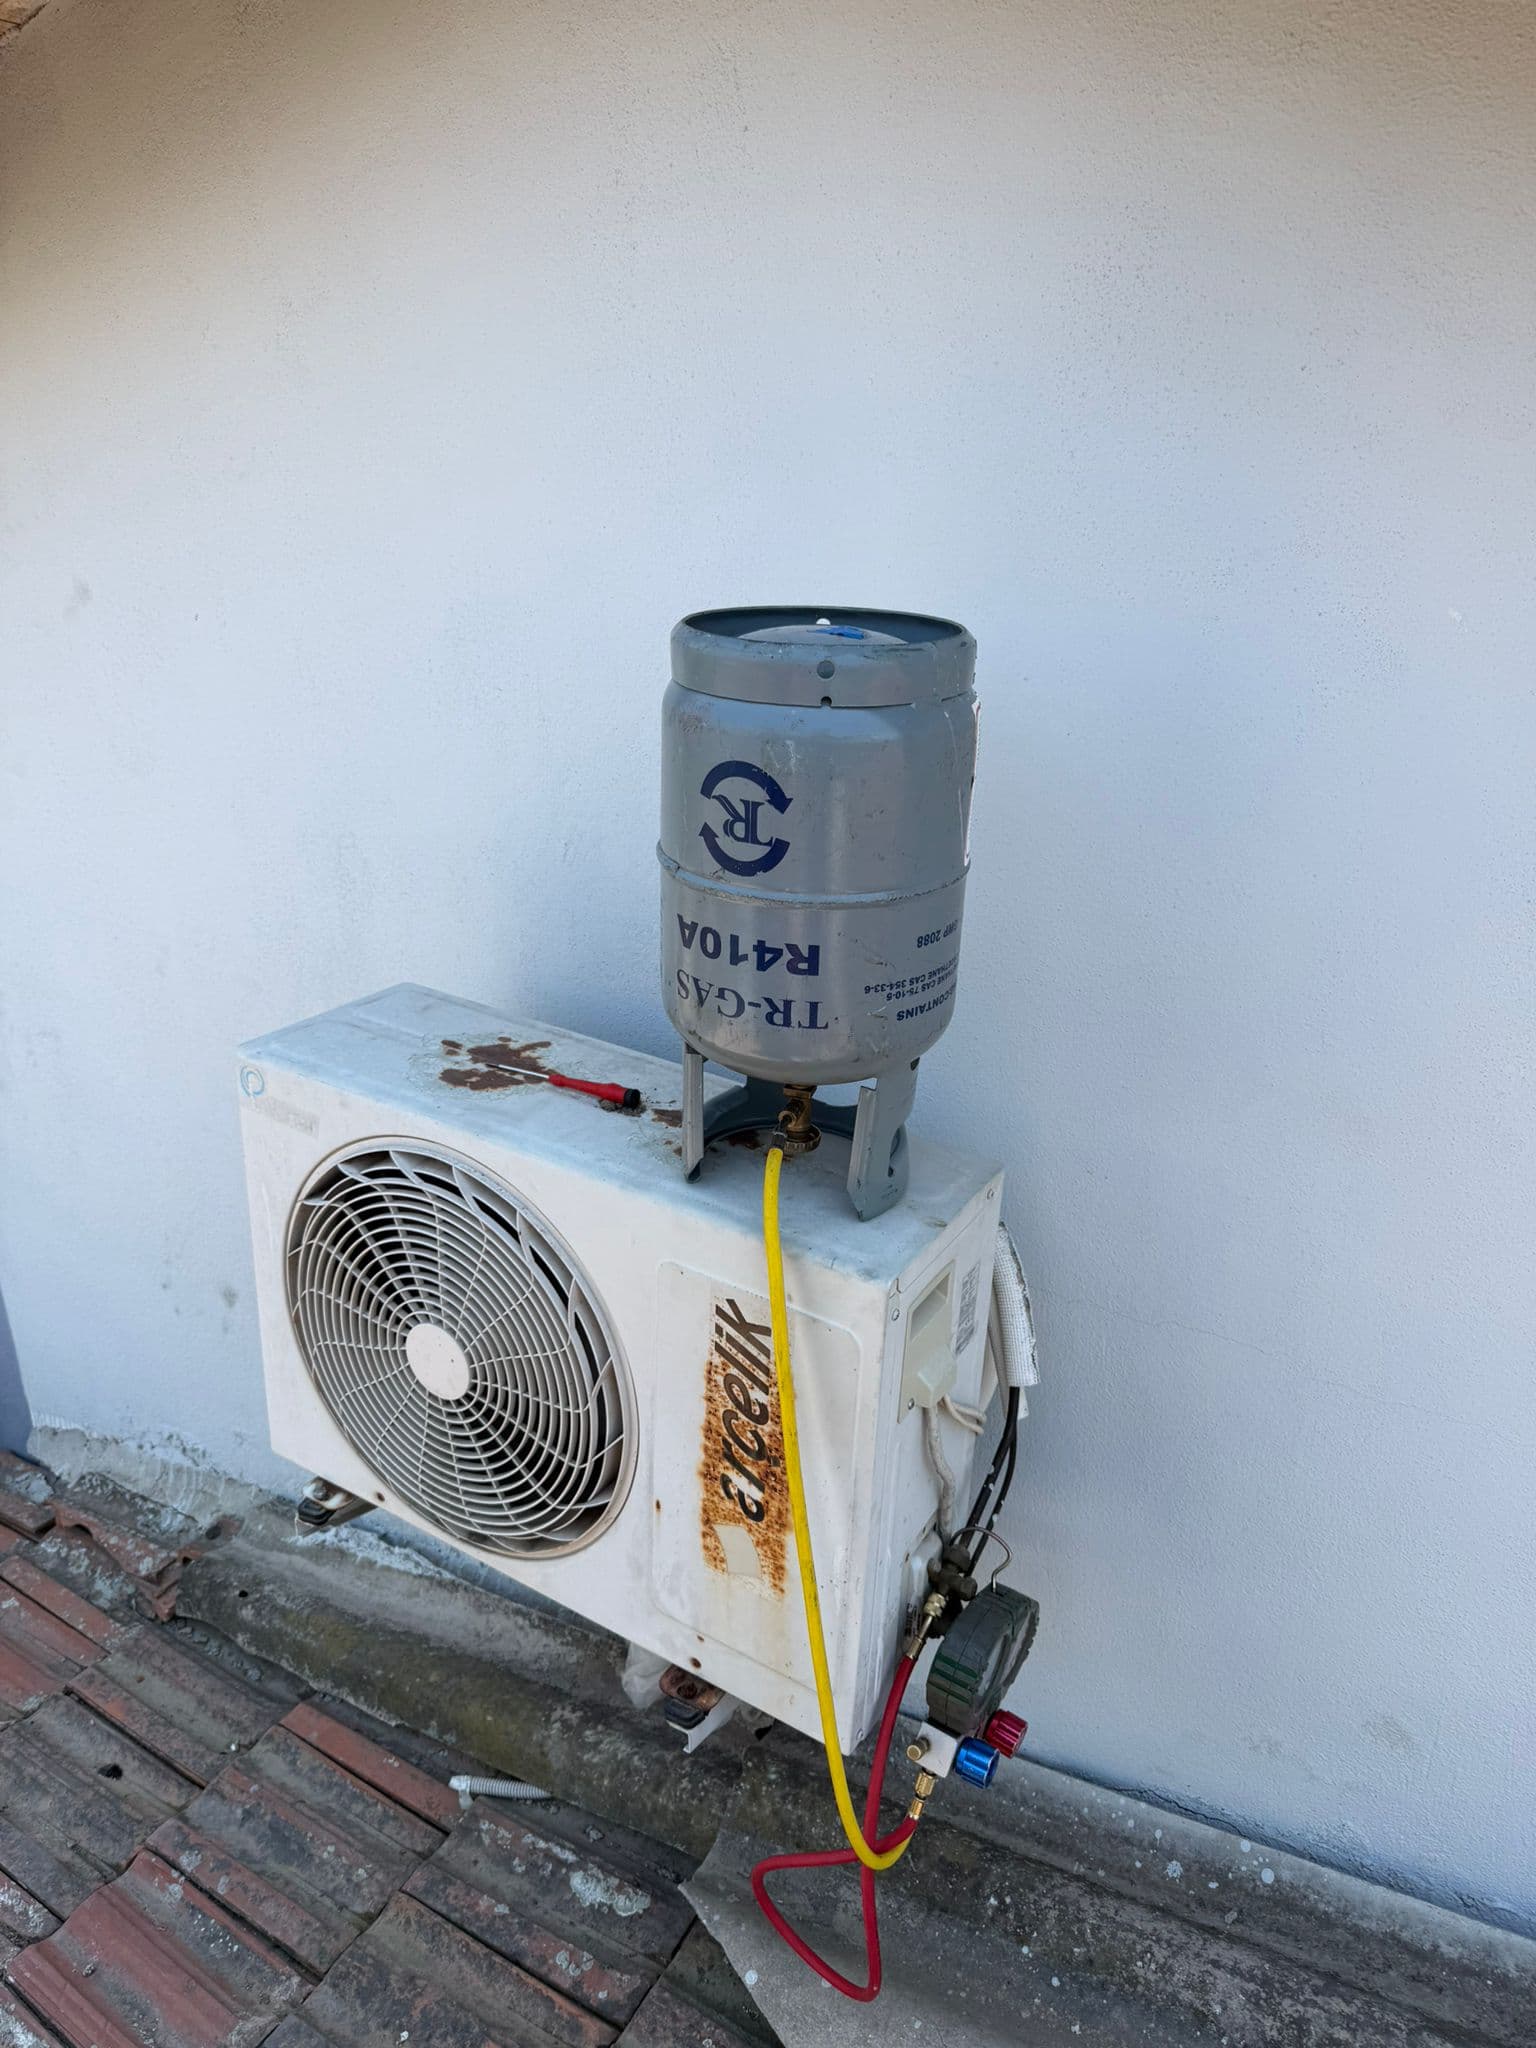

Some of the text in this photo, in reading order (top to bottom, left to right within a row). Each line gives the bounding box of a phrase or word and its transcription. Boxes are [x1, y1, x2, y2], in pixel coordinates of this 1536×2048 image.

[677, 914, 821, 976] R410A
[916, 929, 942, 949] 2088
[864, 979, 907, 995] 354-33-6
[909, 974, 926, 987] CAS
[921, 980, 936, 993] CAS
[675, 969, 829, 1031] TR-GAS
[886, 986, 920, 1002] 75-10-5
[896, 988, 951, 1022] CONTAINS
[715, 1298, 781, 1523] arçelik
